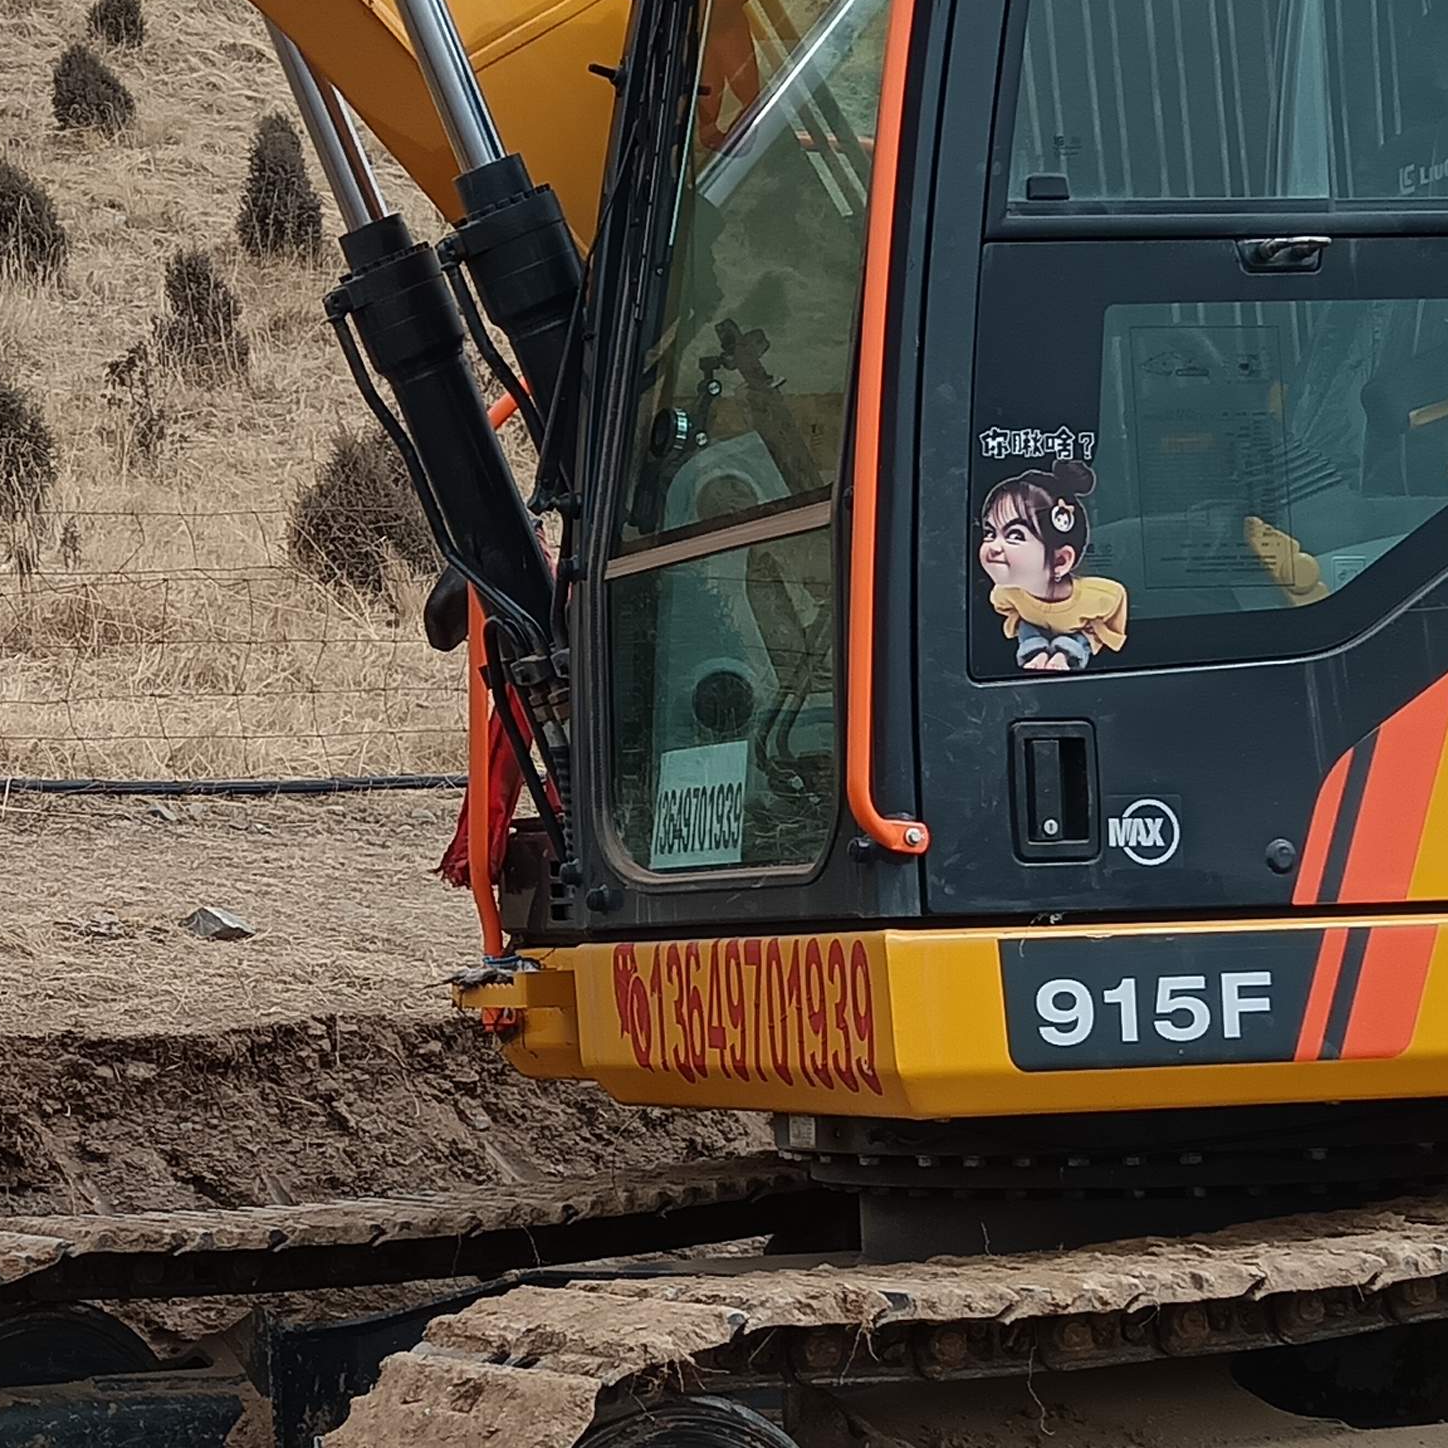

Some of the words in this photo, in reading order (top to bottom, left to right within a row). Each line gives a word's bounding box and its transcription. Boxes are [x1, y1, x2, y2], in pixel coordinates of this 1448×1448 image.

[653, 782, 743, 856] 13649701939
[1107, 817, 1166, 848] MAX
[648, 936, 884, 1098] 13649701939
[1034, 970, 1273, 1047] 915F
